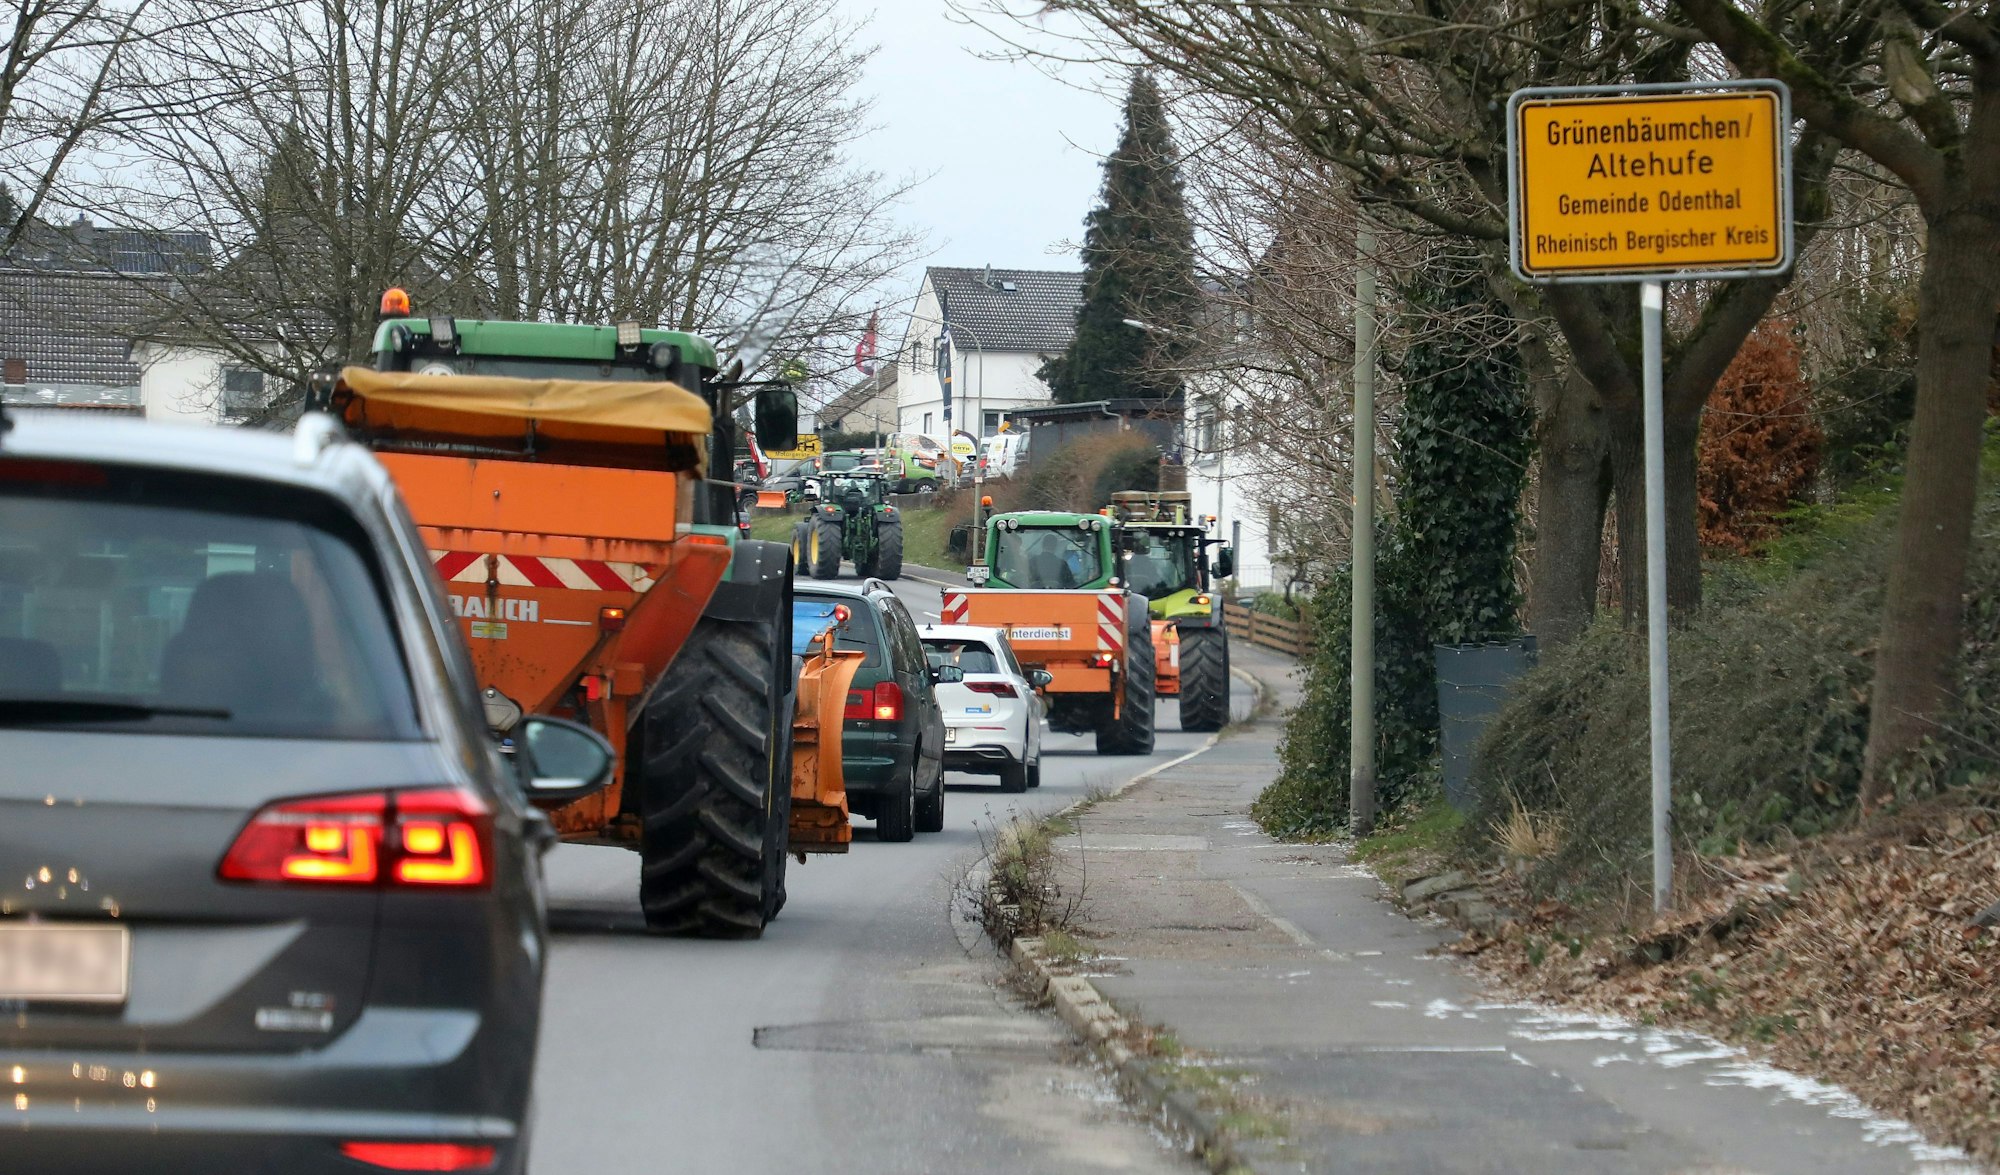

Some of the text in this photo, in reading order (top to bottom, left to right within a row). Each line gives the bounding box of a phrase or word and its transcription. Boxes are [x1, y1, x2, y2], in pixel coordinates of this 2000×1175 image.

[1587, 149, 1714, 179] Altehufe
[1558, 187, 1742, 215] Gemeinde Odenthal
[1536, 225, 1769, 254] Rheinisch Bergischer Kreis
